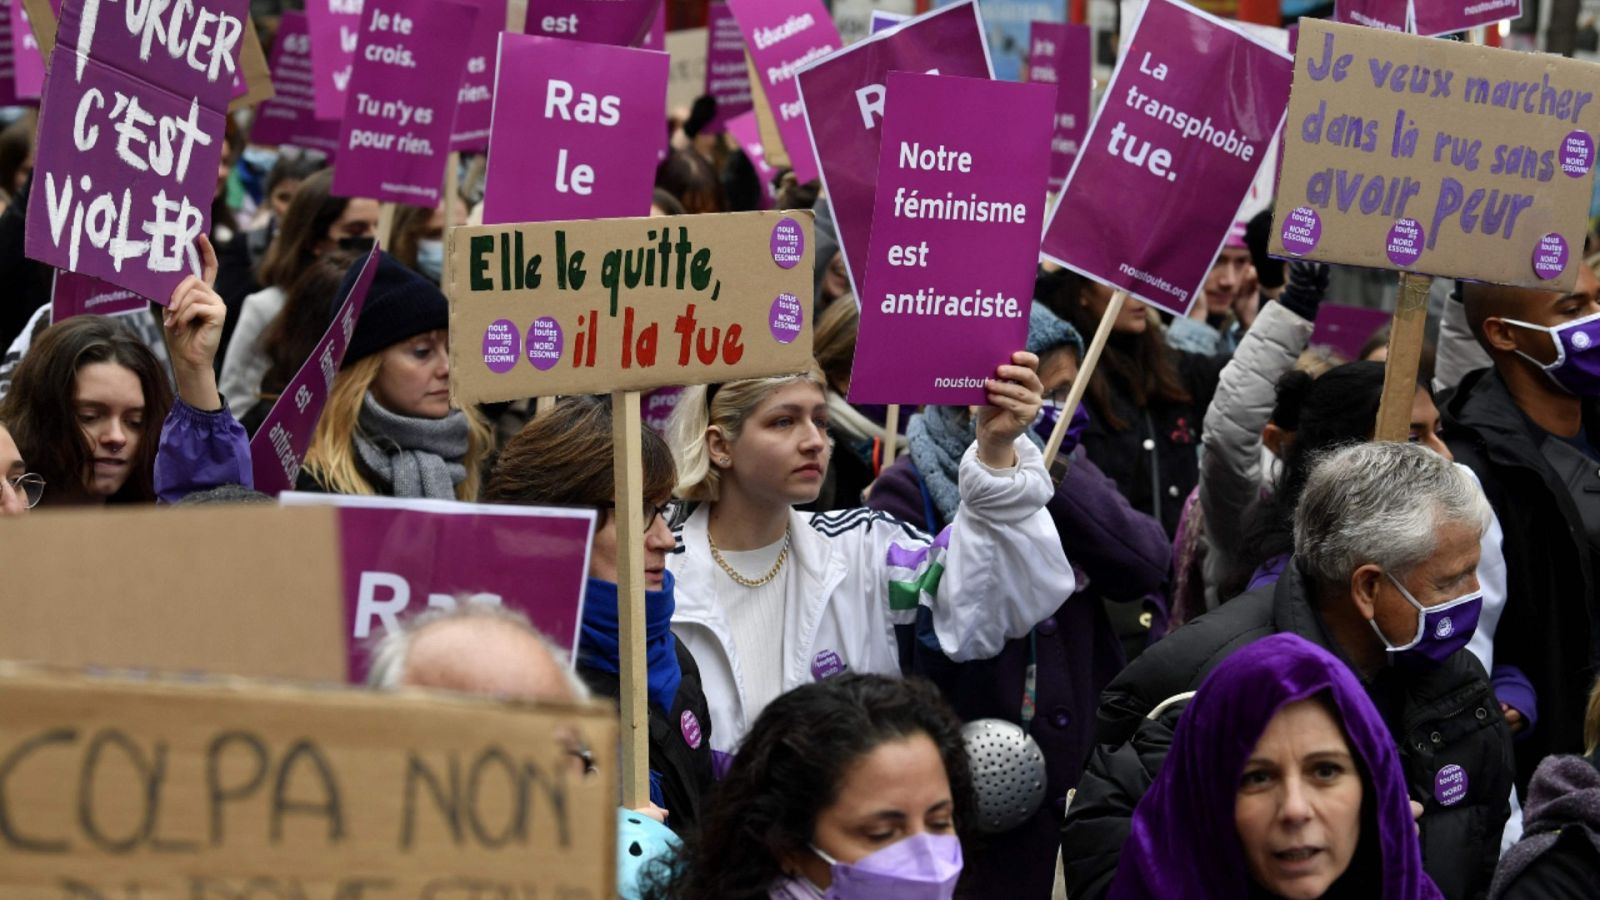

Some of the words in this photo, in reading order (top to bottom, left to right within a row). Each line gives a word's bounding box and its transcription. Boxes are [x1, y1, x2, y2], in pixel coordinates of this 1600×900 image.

[370, 8, 390, 32] Je
[392, 13, 413, 35] te
[541, 14, 579, 34] est
[364, 44, 416, 68] crois.
[467, 56, 486, 74] es
[1139, 51, 1169, 81] La
[457, 82, 491, 104] rien.
[1307, 32, 1354, 83] Je
[1369, 58, 1454, 98] veux
[1464, 73, 1593, 124] marcher
[357, 93, 380, 116] Tu
[382, 100, 412, 126] n'y
[414, 107, 433, 124] es
[544, 79, 621, 127] Ras
[73, 88, 212, 184] C'EST
[1125, 86, 1254, 162] transphobie
[349, 129, 395, 150] pour
[397, 132, 434, 156] rien.
[1108, 121, 1177, 181] tue.
[1301, 100, 1378, 153] dans
[1433, 131, 1483, 172] rue
[1490, 144, 1555, 182] sans
[555, 148, 595, 195] le
[899, 141, 972, 173] Notre
[894, 187, 1026, 224] féminisme
[1306, 167, 1420, 218] avoir
[777, 246, 796, 254] NORD
[888, 241, 930, 268] est
[470, 229, 542, 291] Elle
[555, 230, 587, 291] le
[601, 226, 721, 317] quitte,
[1119, 262, 1189, 302] noustoutes.org
[880, 286, 1023, 318] antiraciste.
[534, 320, 553, 328] nous
[534, 328, 558, 336] toutes
[778, 313, 796, 323] NORD
[488, 332, 512, 340] toutes
[488, 346, 510, 354] NORD
[534, 342, 555, 350] NORD
[572, 310, 599, 369] il
[621, 306, 658, 369] la
[674, 304, 744, 367] tue
[484, 355, 515, 363] ESSONNE
[529, 350, 560, 359] ESSONNE
[294, 383, 314, 414] est
[0, 727, 347, 854] COLPA
[400, 747, 571, 848] NON
